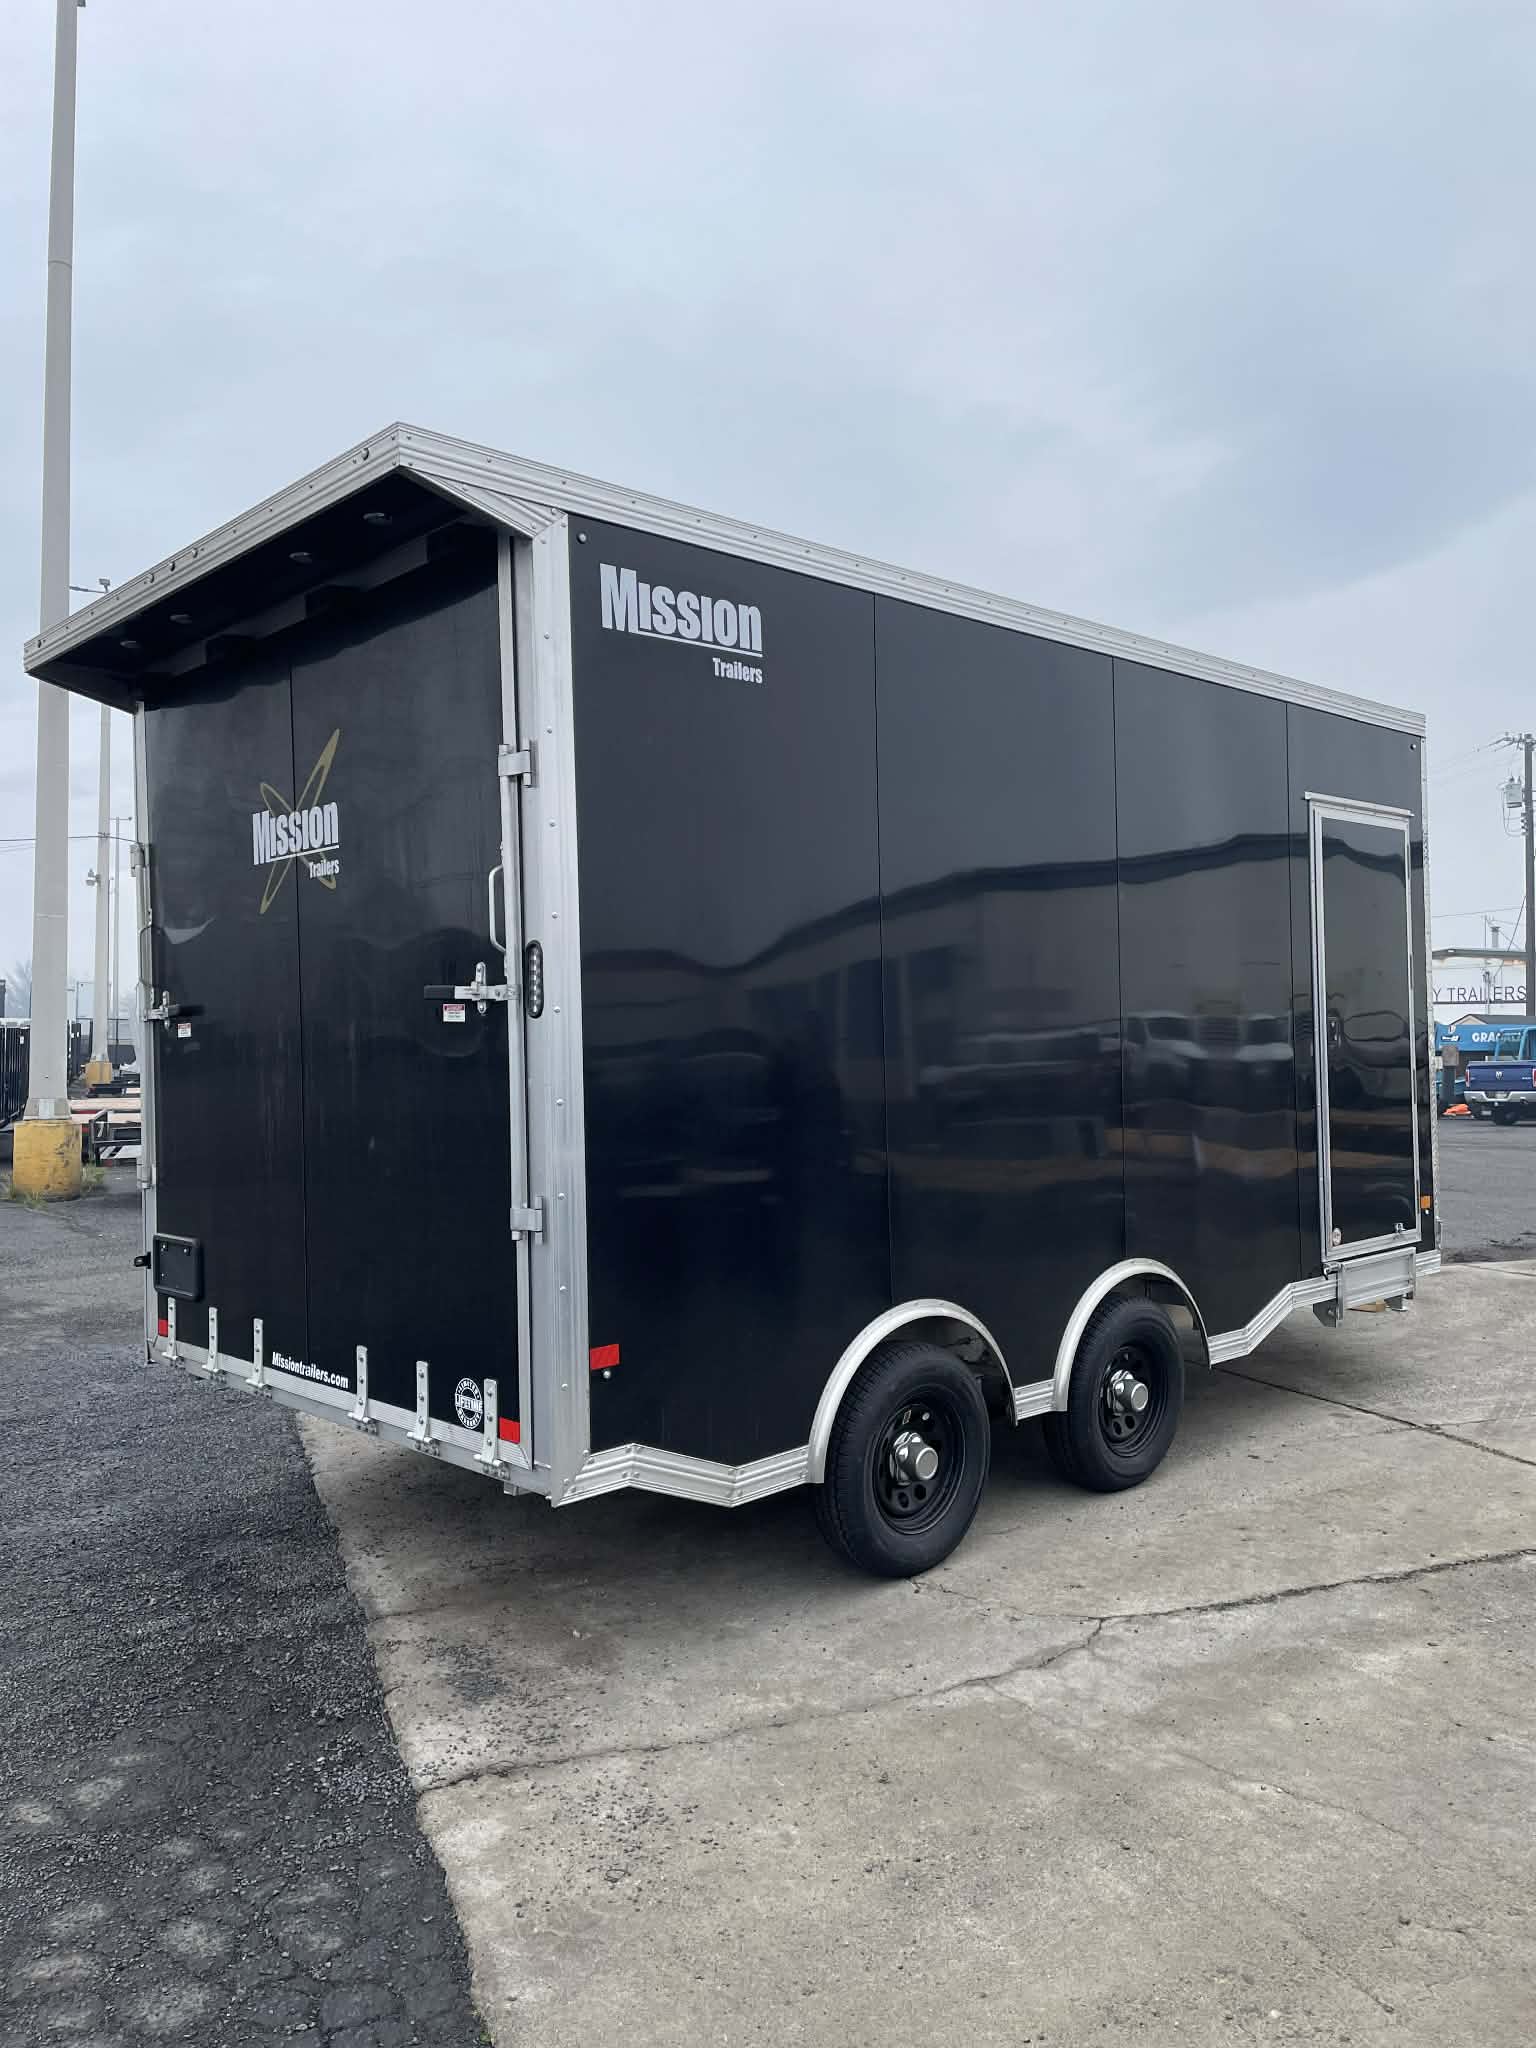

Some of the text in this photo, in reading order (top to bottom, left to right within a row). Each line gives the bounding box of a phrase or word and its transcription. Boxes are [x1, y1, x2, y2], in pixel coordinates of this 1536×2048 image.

[712, 657, 763, 684] Trailers
[308, 859, 340, 879] Trailers
[272, 1351, 349, 1388] Missiontrailers.com
